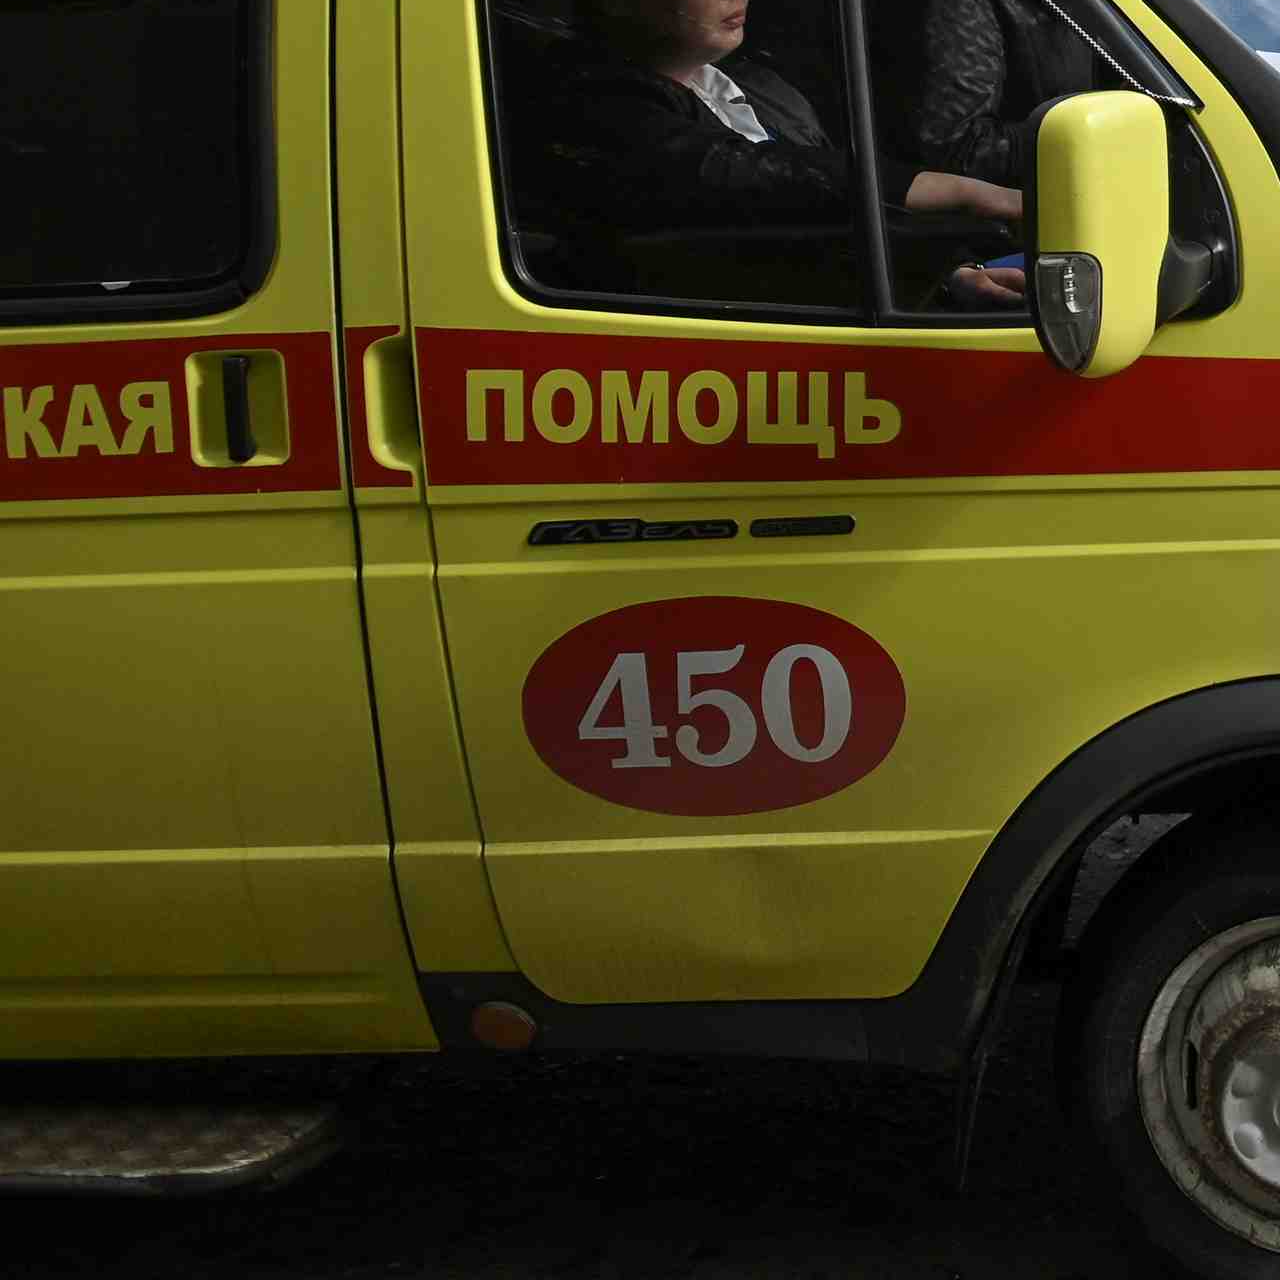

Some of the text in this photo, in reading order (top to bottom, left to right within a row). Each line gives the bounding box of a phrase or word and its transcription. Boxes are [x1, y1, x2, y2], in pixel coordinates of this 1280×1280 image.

[3, 369, 902, 459] КАЯ ПОМОЩЬ
[578, 644, 852, 768] 450
